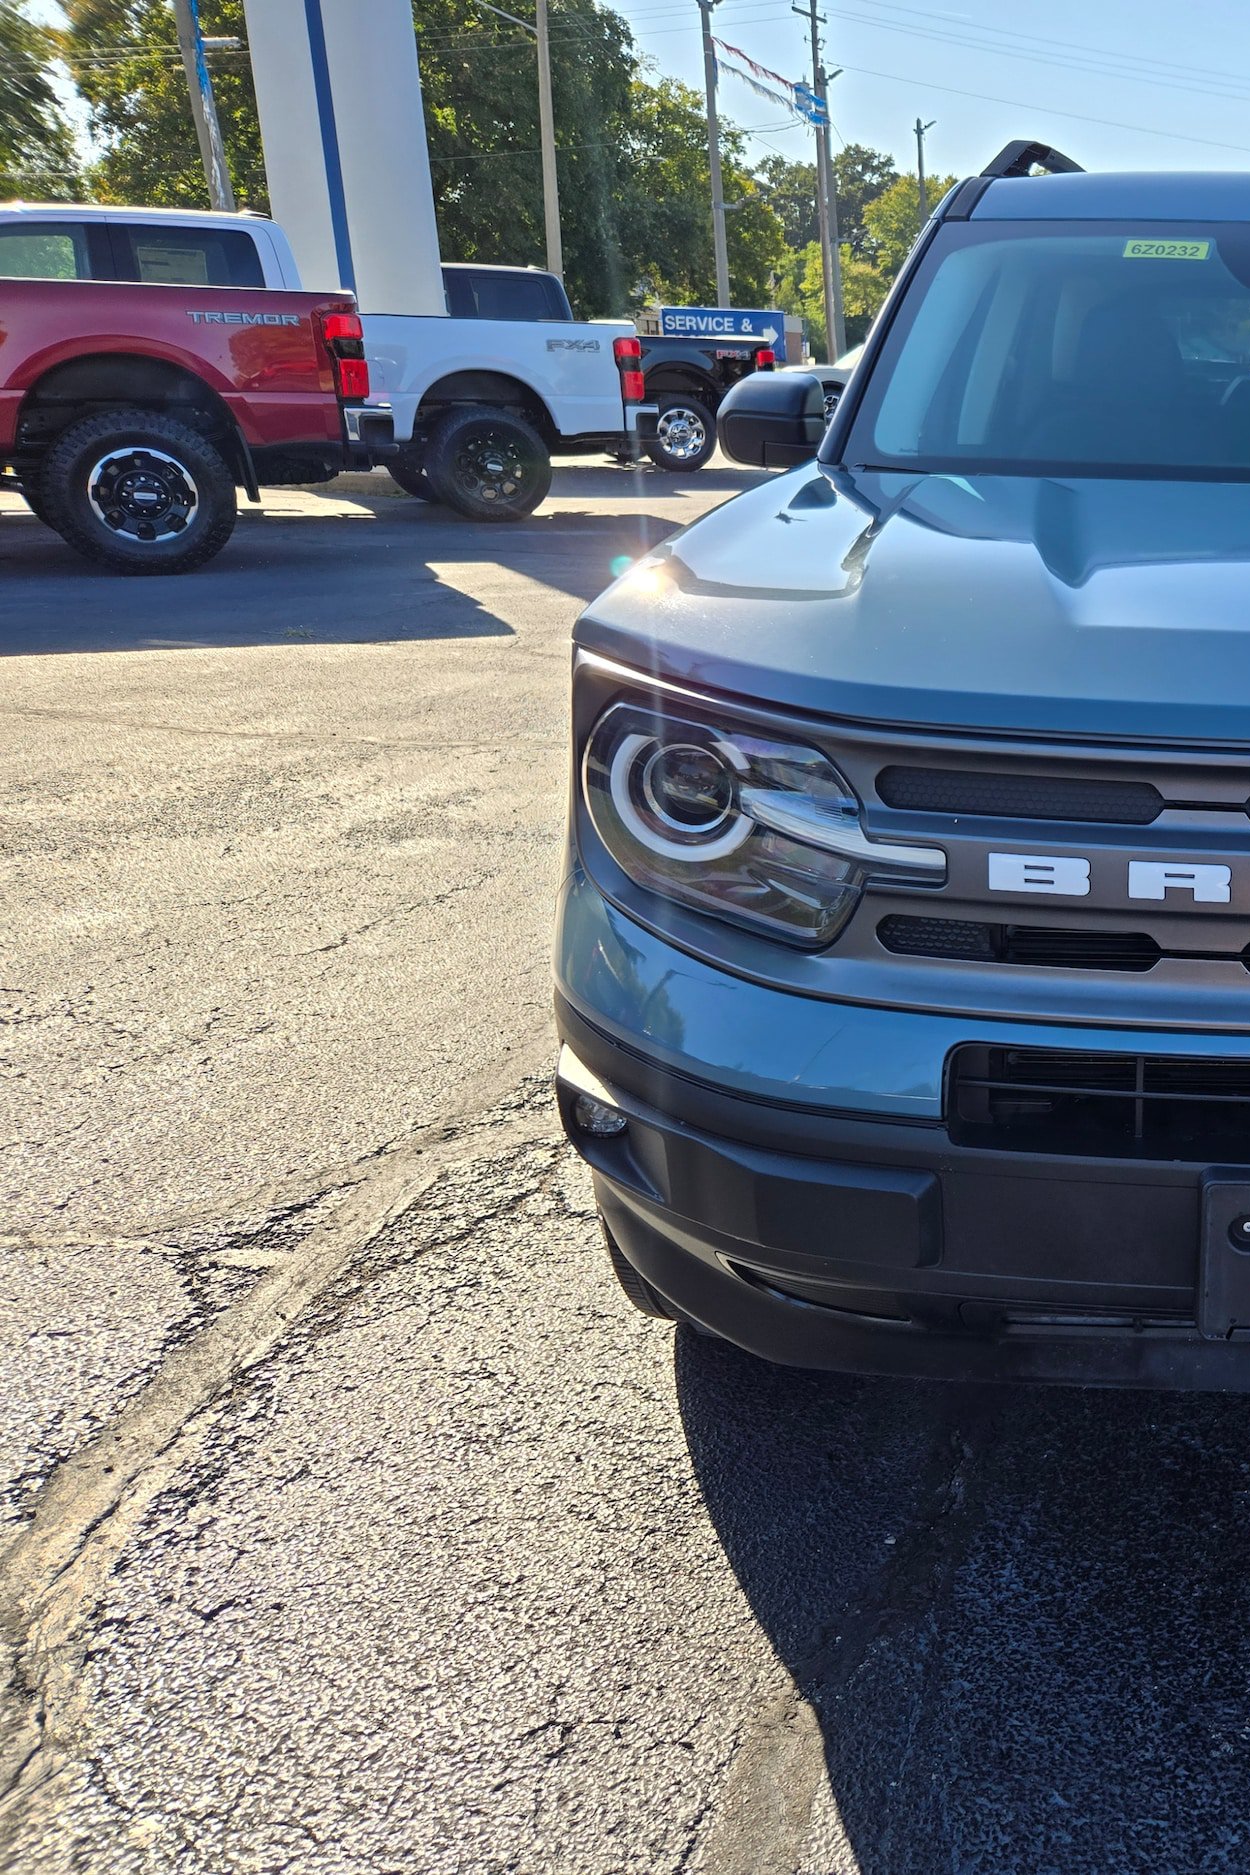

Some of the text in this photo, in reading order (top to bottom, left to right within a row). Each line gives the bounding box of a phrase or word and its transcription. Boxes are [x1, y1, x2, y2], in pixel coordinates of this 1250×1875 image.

[1131, 244, 1200, 257] 6Z0232
[186, 311, 300, 326] TREMOR
[665, 315, 753, 332] SERVICE &
[546, 339, 600, 353] FX4
